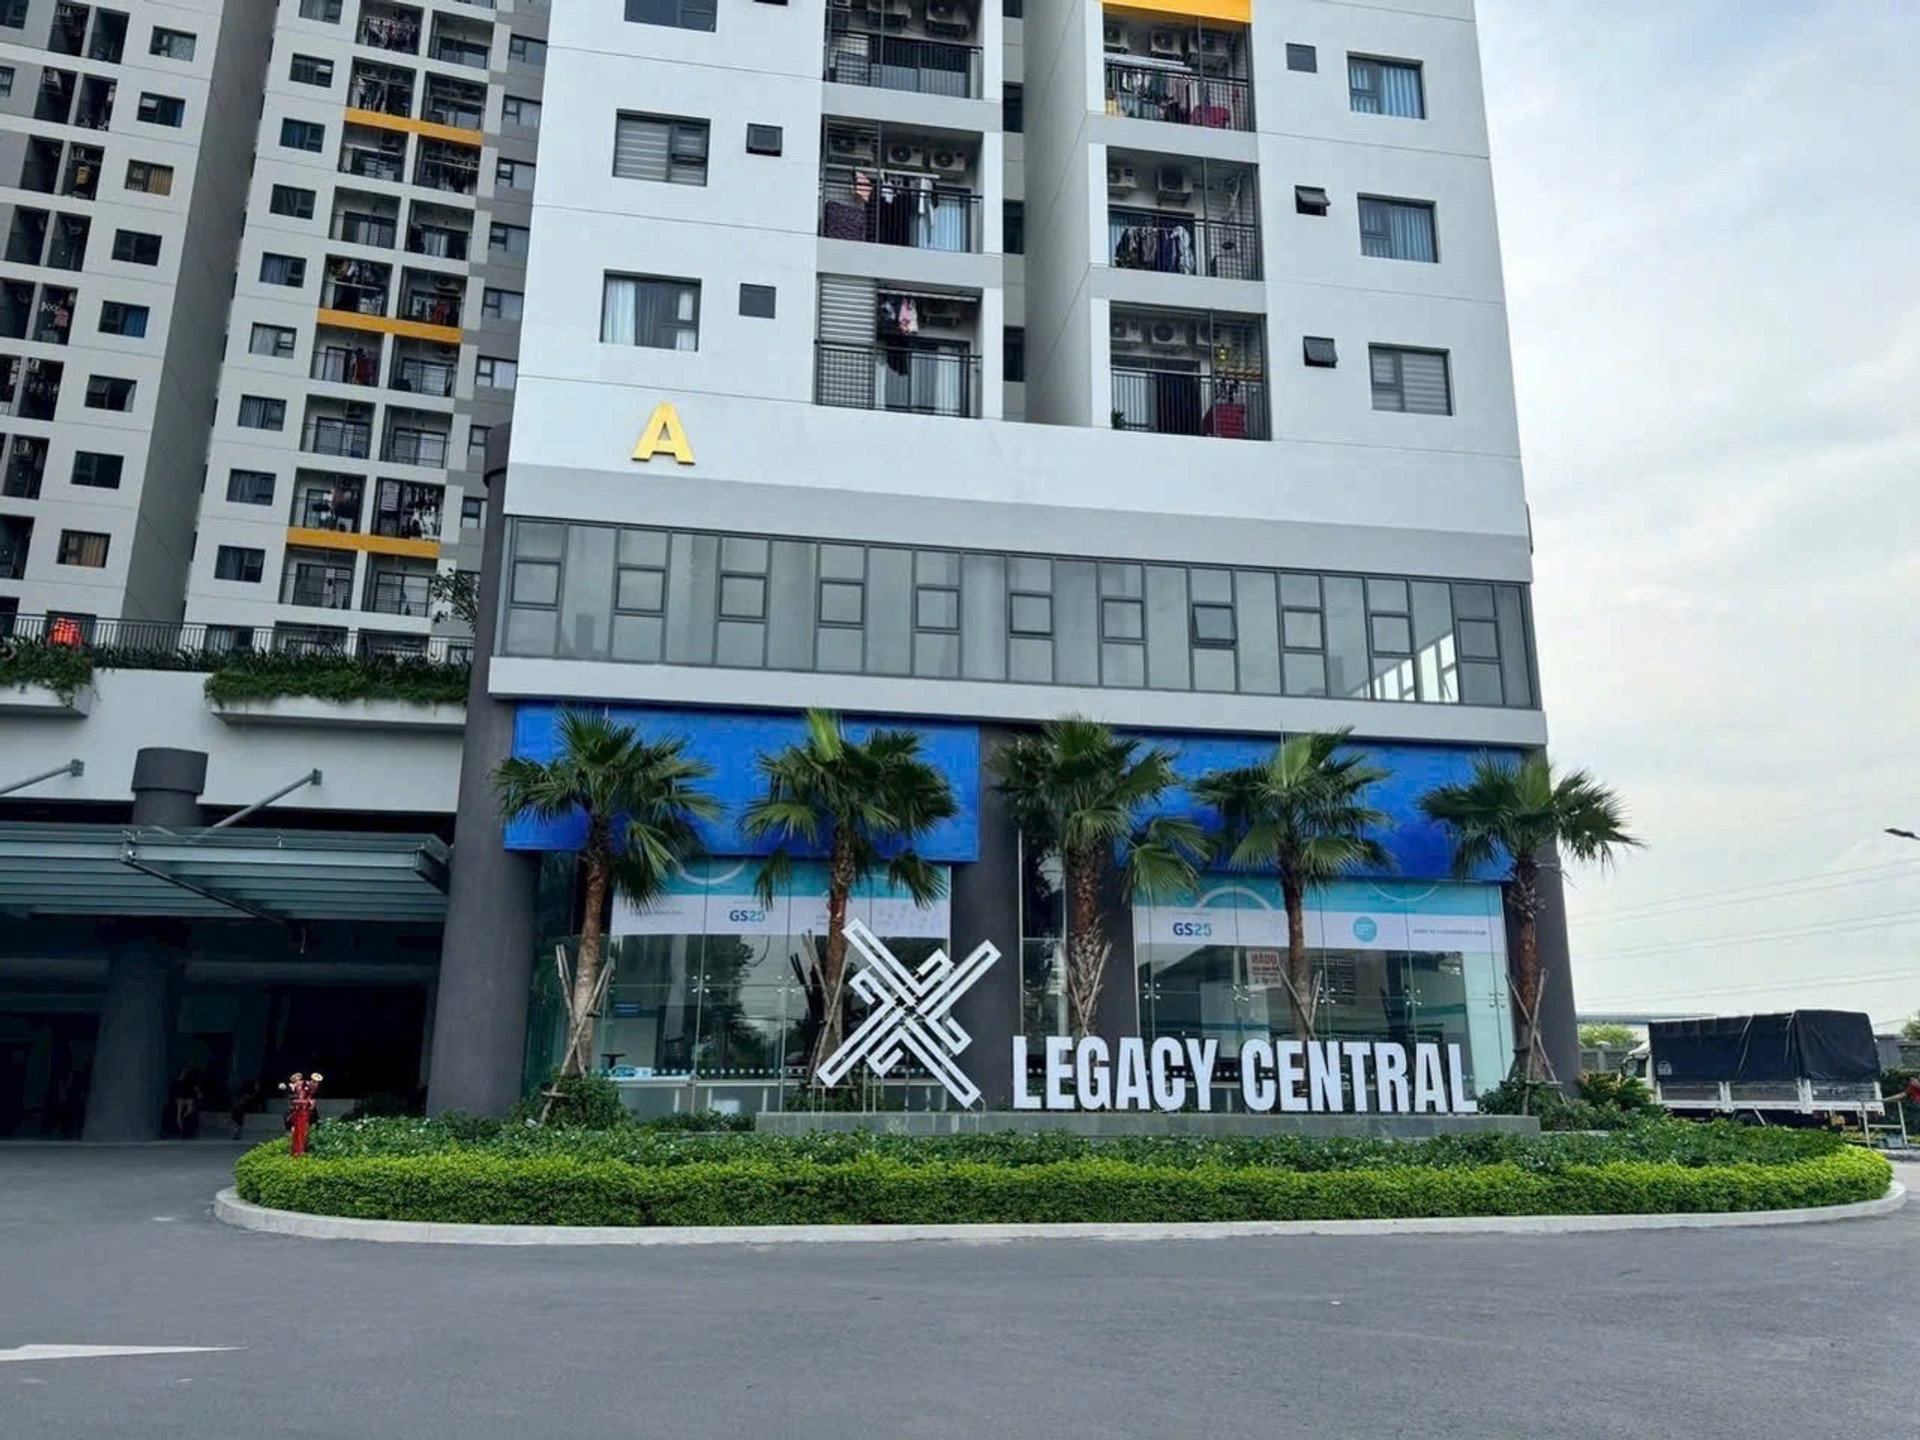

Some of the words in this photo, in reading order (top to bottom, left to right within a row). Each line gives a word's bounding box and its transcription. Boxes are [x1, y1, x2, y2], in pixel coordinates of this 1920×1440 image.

[631, 402, 695, 465] A
[1173, 922, 1212, 937] GS25
[1012, 1036, 1219, 1112] LEGACY
[1241, 1038, 1477, 1113] CENTRAL
